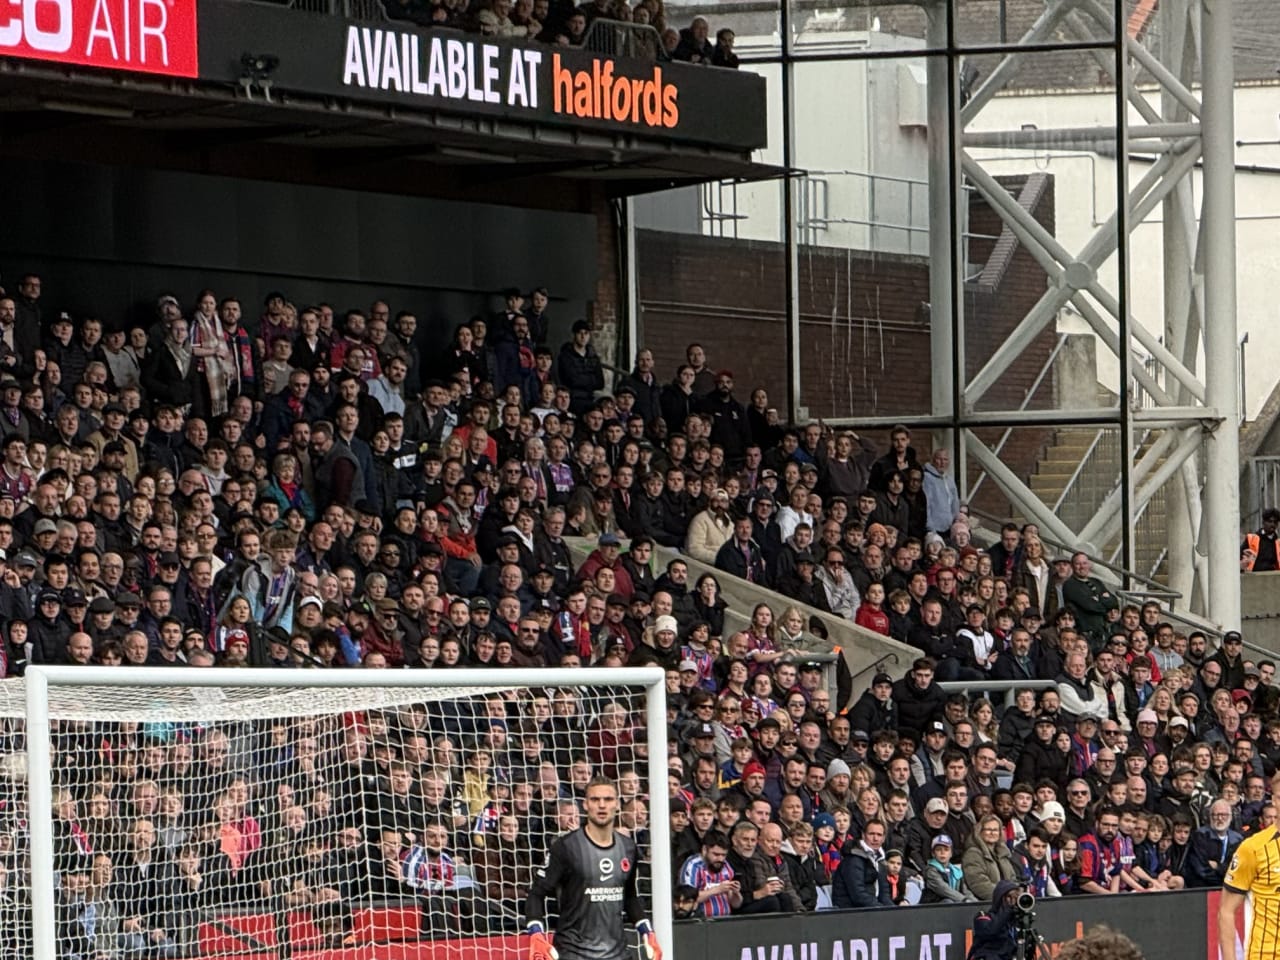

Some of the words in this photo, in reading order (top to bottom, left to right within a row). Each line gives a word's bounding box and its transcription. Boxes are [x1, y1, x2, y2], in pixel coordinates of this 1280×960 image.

[86, 0, 168, 66] AIR
[344, 26, 500, 103] AVAILABLE
[507, 49, 542, 108] AT
[552, 53, 679, 128] halfords
